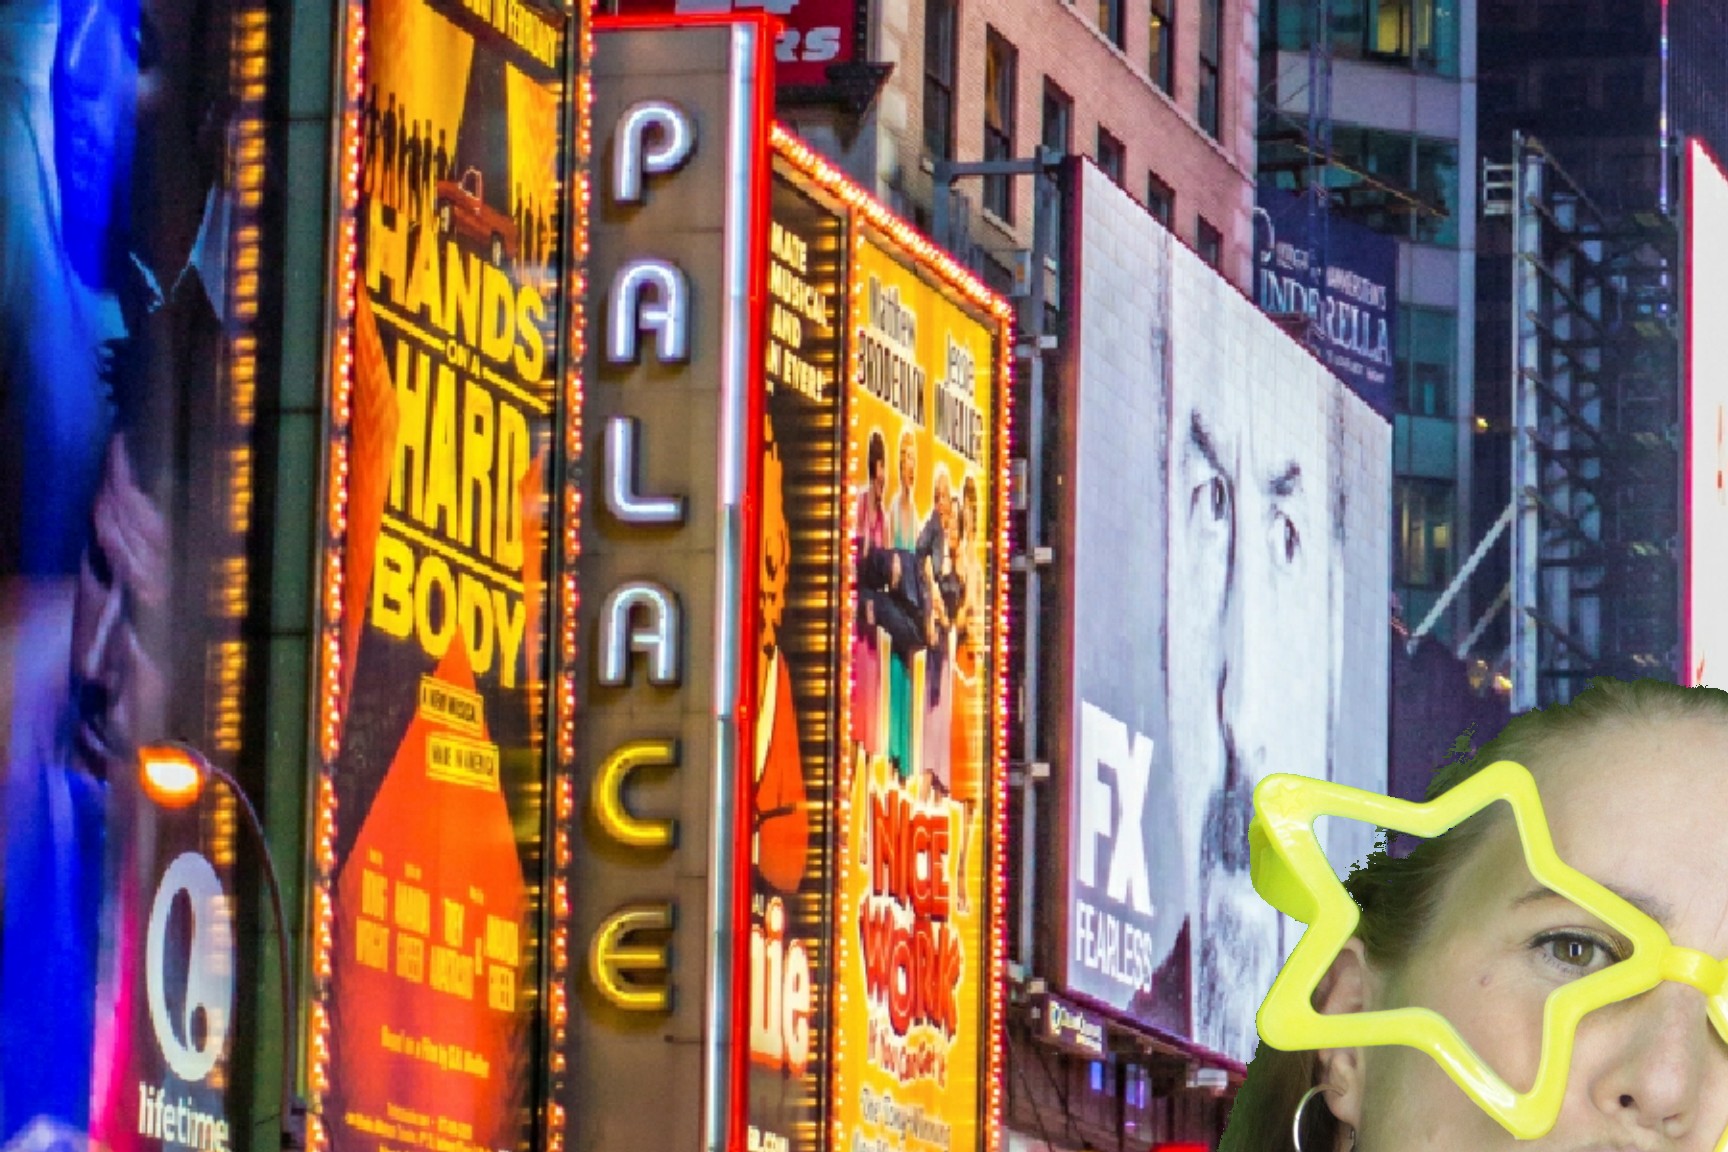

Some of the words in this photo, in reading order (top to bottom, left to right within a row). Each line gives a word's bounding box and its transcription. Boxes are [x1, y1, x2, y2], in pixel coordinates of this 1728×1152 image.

[364, 196, 546, 384] HANDS
[390, 338, 531, 573] HARD
[370, 534, 527, 690] BODY
[590, 99, 695, 1014] PALACE
[866, 788, 951, 922] NICE
[1078, 698, 1154, 917] FX
[858, 898, 962, 1042] WORK
[1074, 899, 1153, 994] FEARLESS
